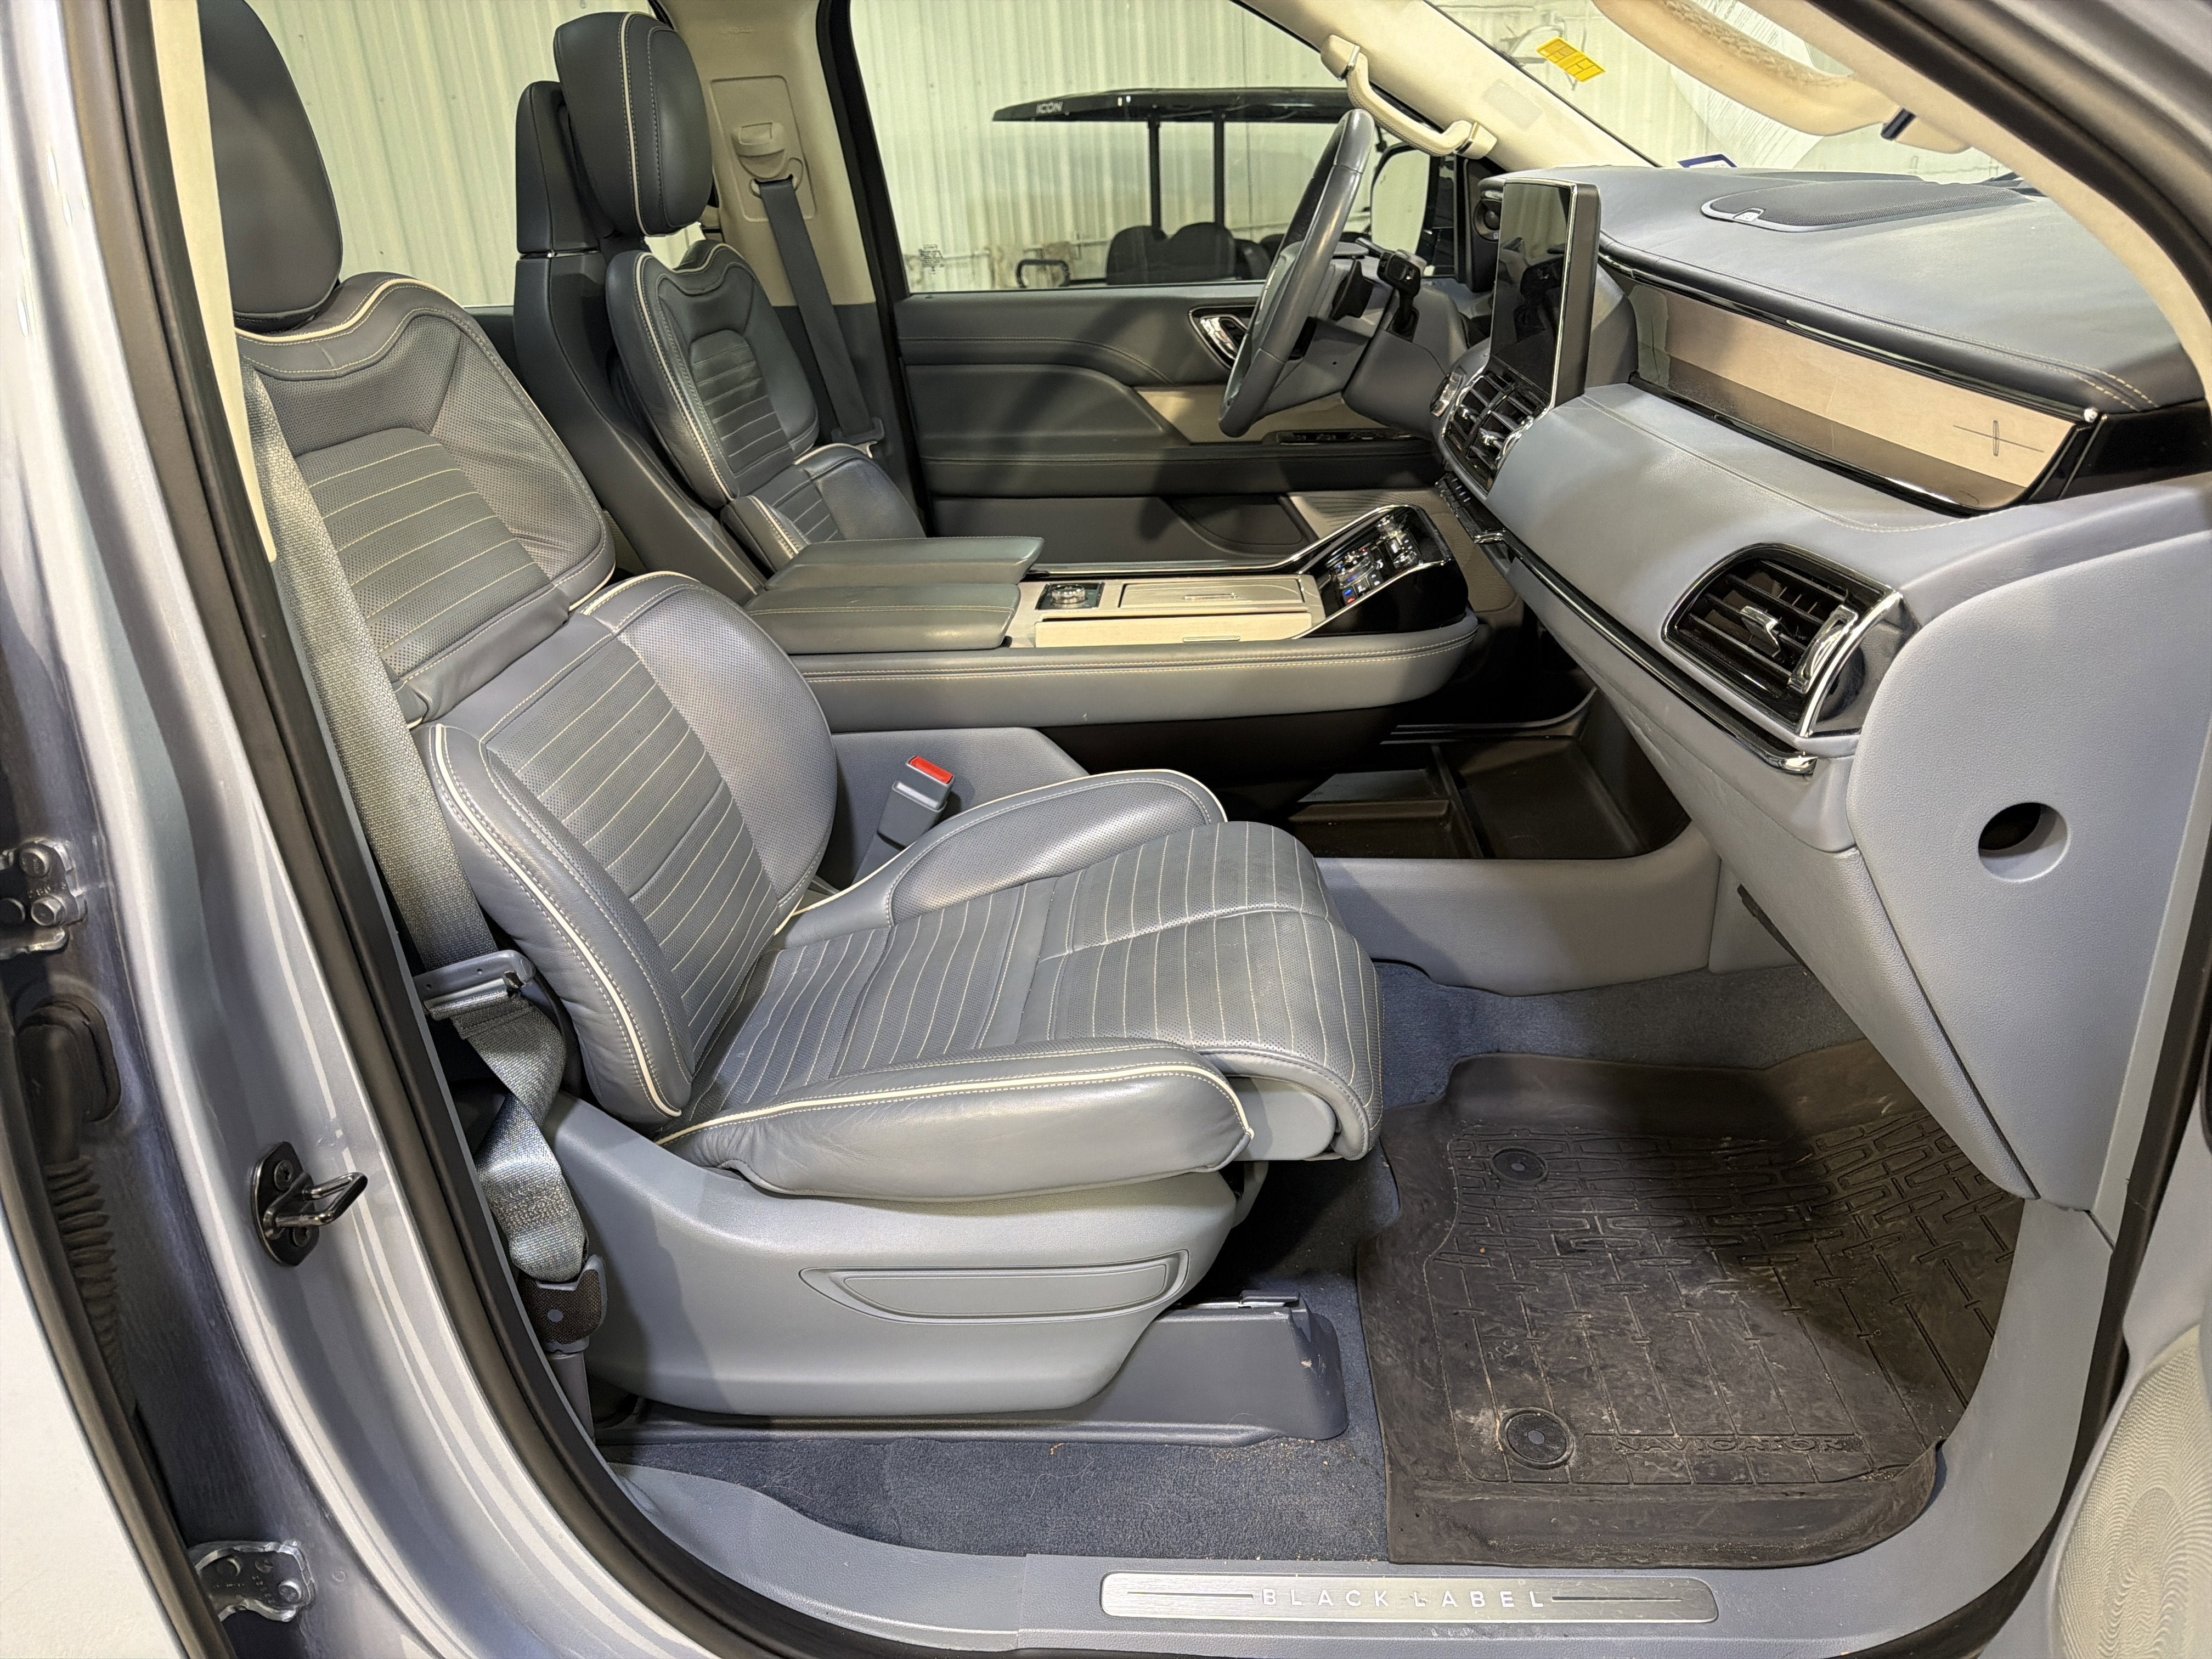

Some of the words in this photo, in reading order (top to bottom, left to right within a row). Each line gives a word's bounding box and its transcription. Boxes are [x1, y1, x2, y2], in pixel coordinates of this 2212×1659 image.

[1612, 1437, 1844, 1452] NAVIGATOR
[1262, 1588, 1389, 1607] BLACK
[1413, 1590, 1544, 1607] LABEL
